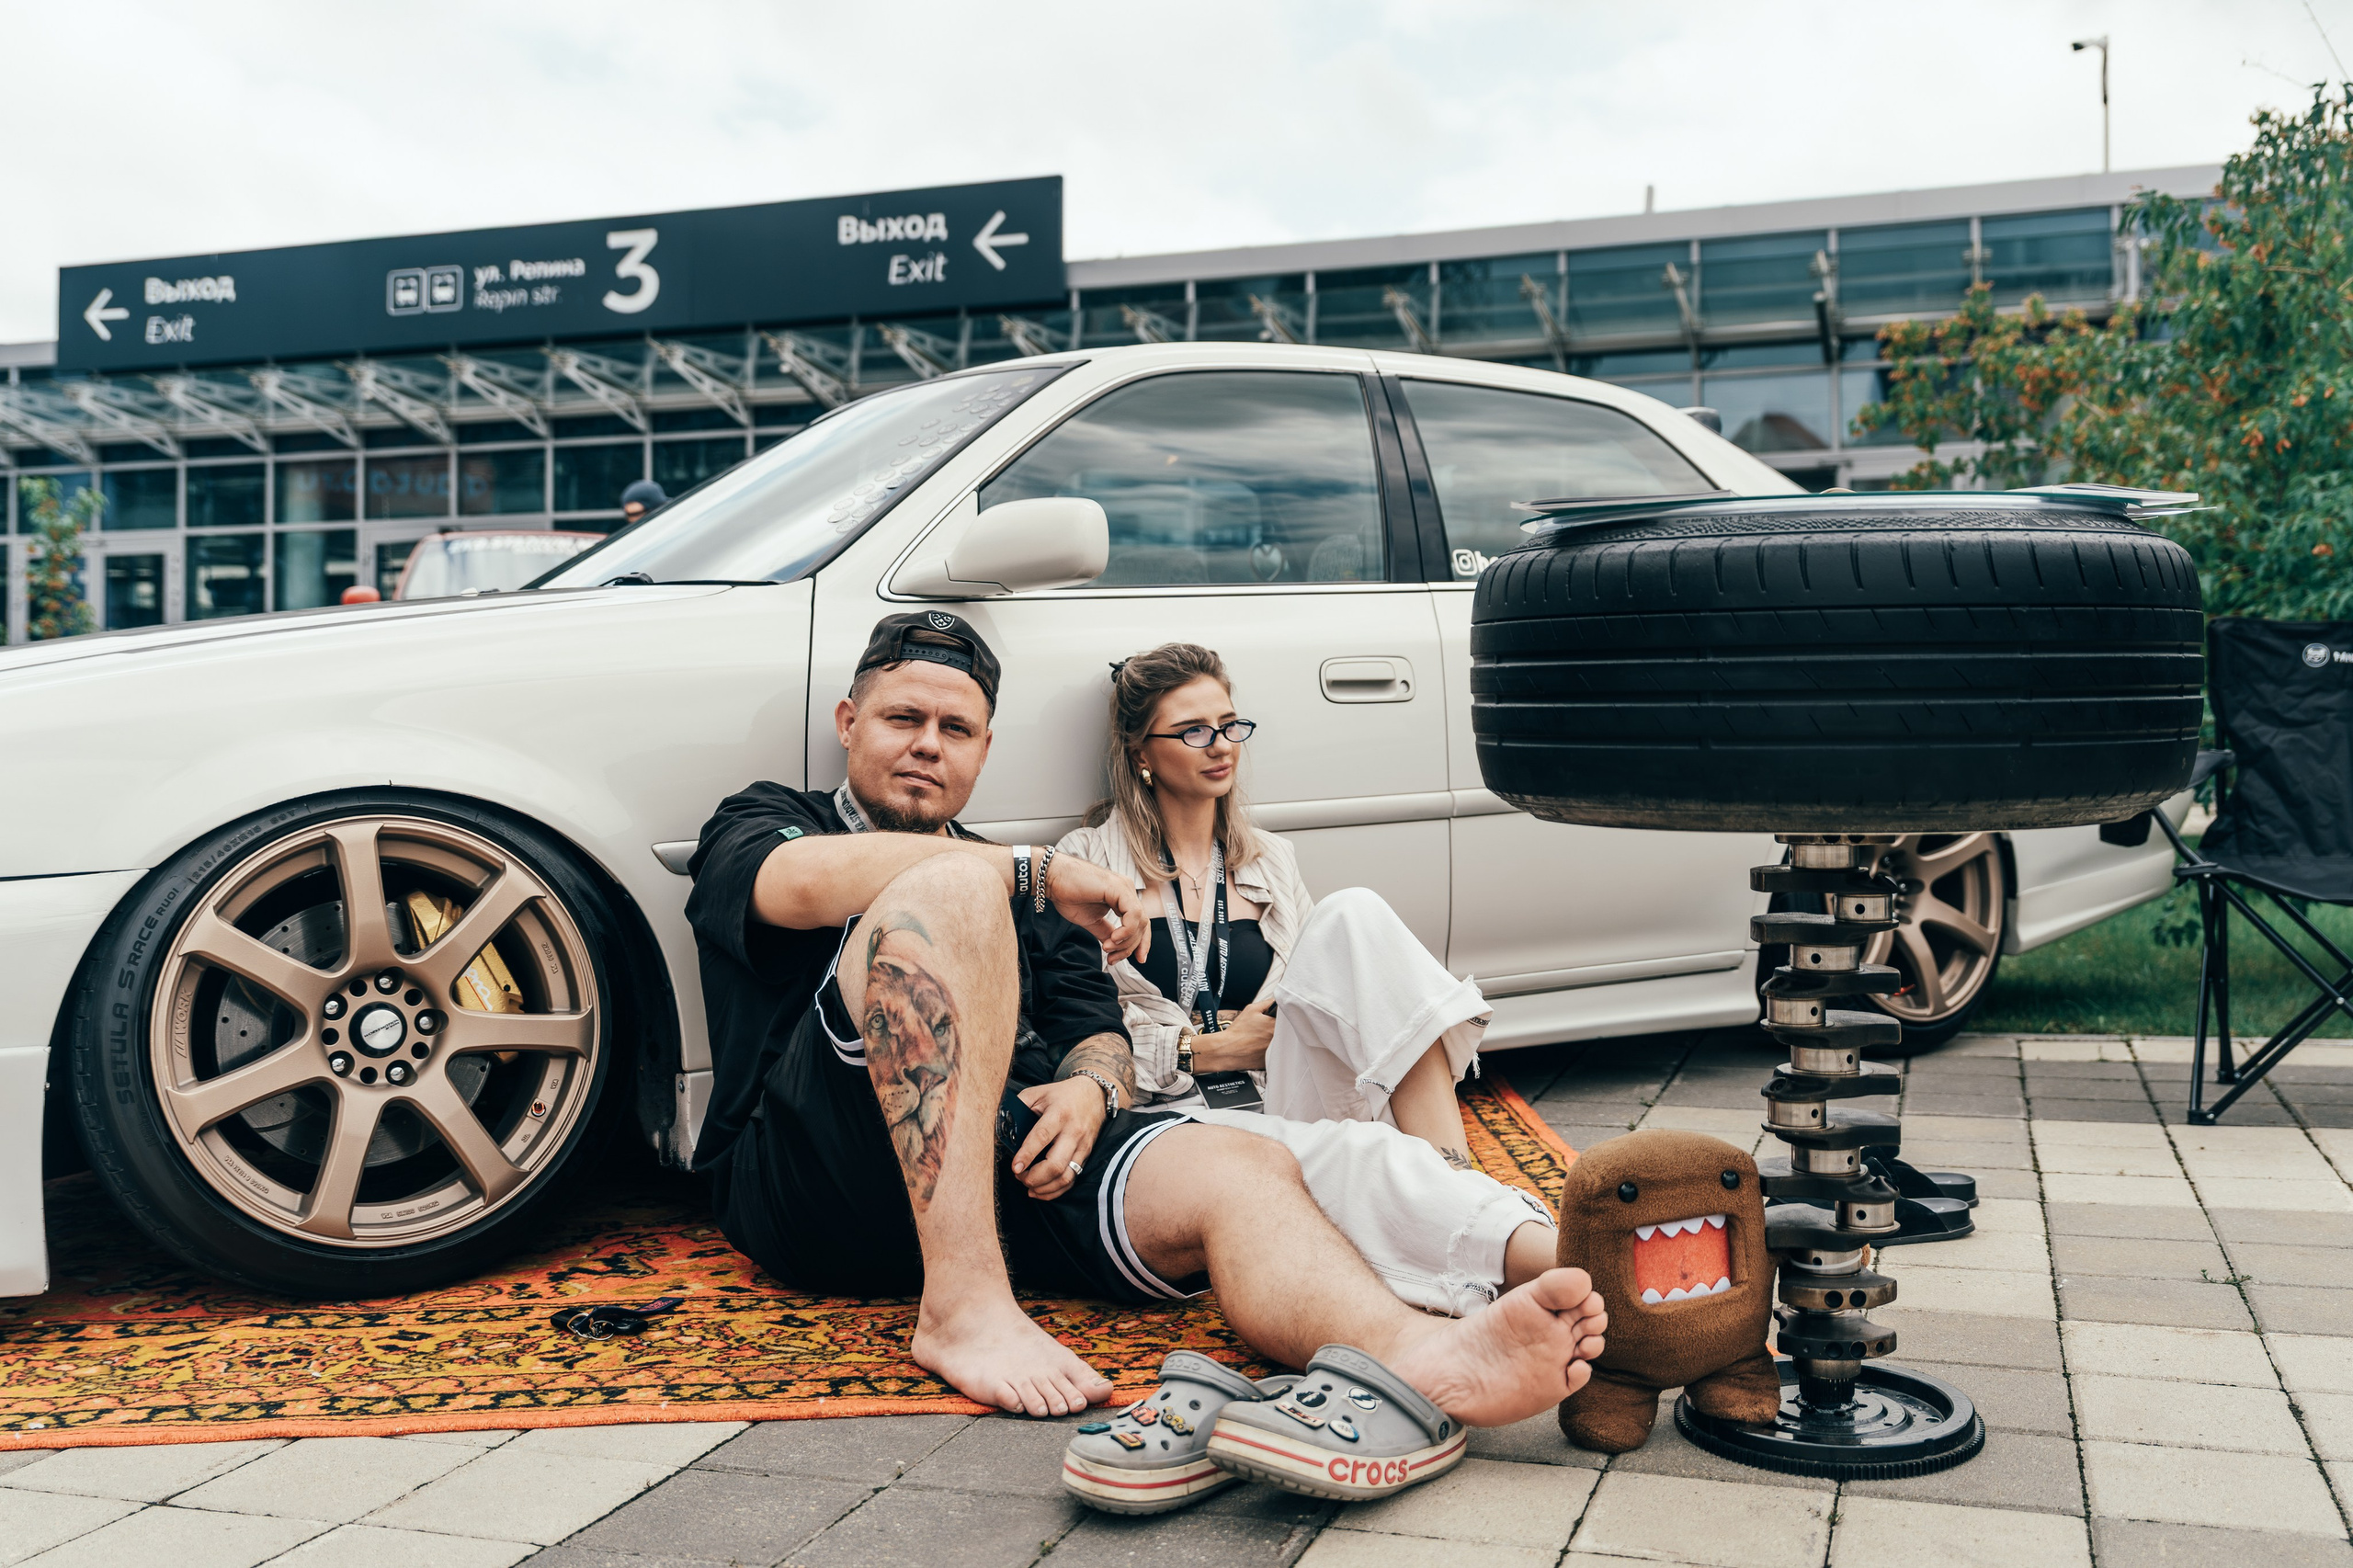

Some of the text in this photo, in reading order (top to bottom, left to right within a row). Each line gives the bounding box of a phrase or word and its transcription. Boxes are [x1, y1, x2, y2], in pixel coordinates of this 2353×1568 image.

[837, 212, 949, 245] Выход
[602, 227, 660, 313] 3
[888, 251, 949, 285] Exit
[144, 275, 236, 305] Выход
[144, 313, 197, 345] Exit
[1017, 857, 1029, 892] auto.r
[127, 915, 160, 968] RACE
[1218, 937, 1229, 958] AUTO
[118, 967, 136, 992] S
[176, 990, 193, 1036] WORK
[110, 1002, 136, 1105] SETULA
[1328, 1457, 1408, 1486] crocs
